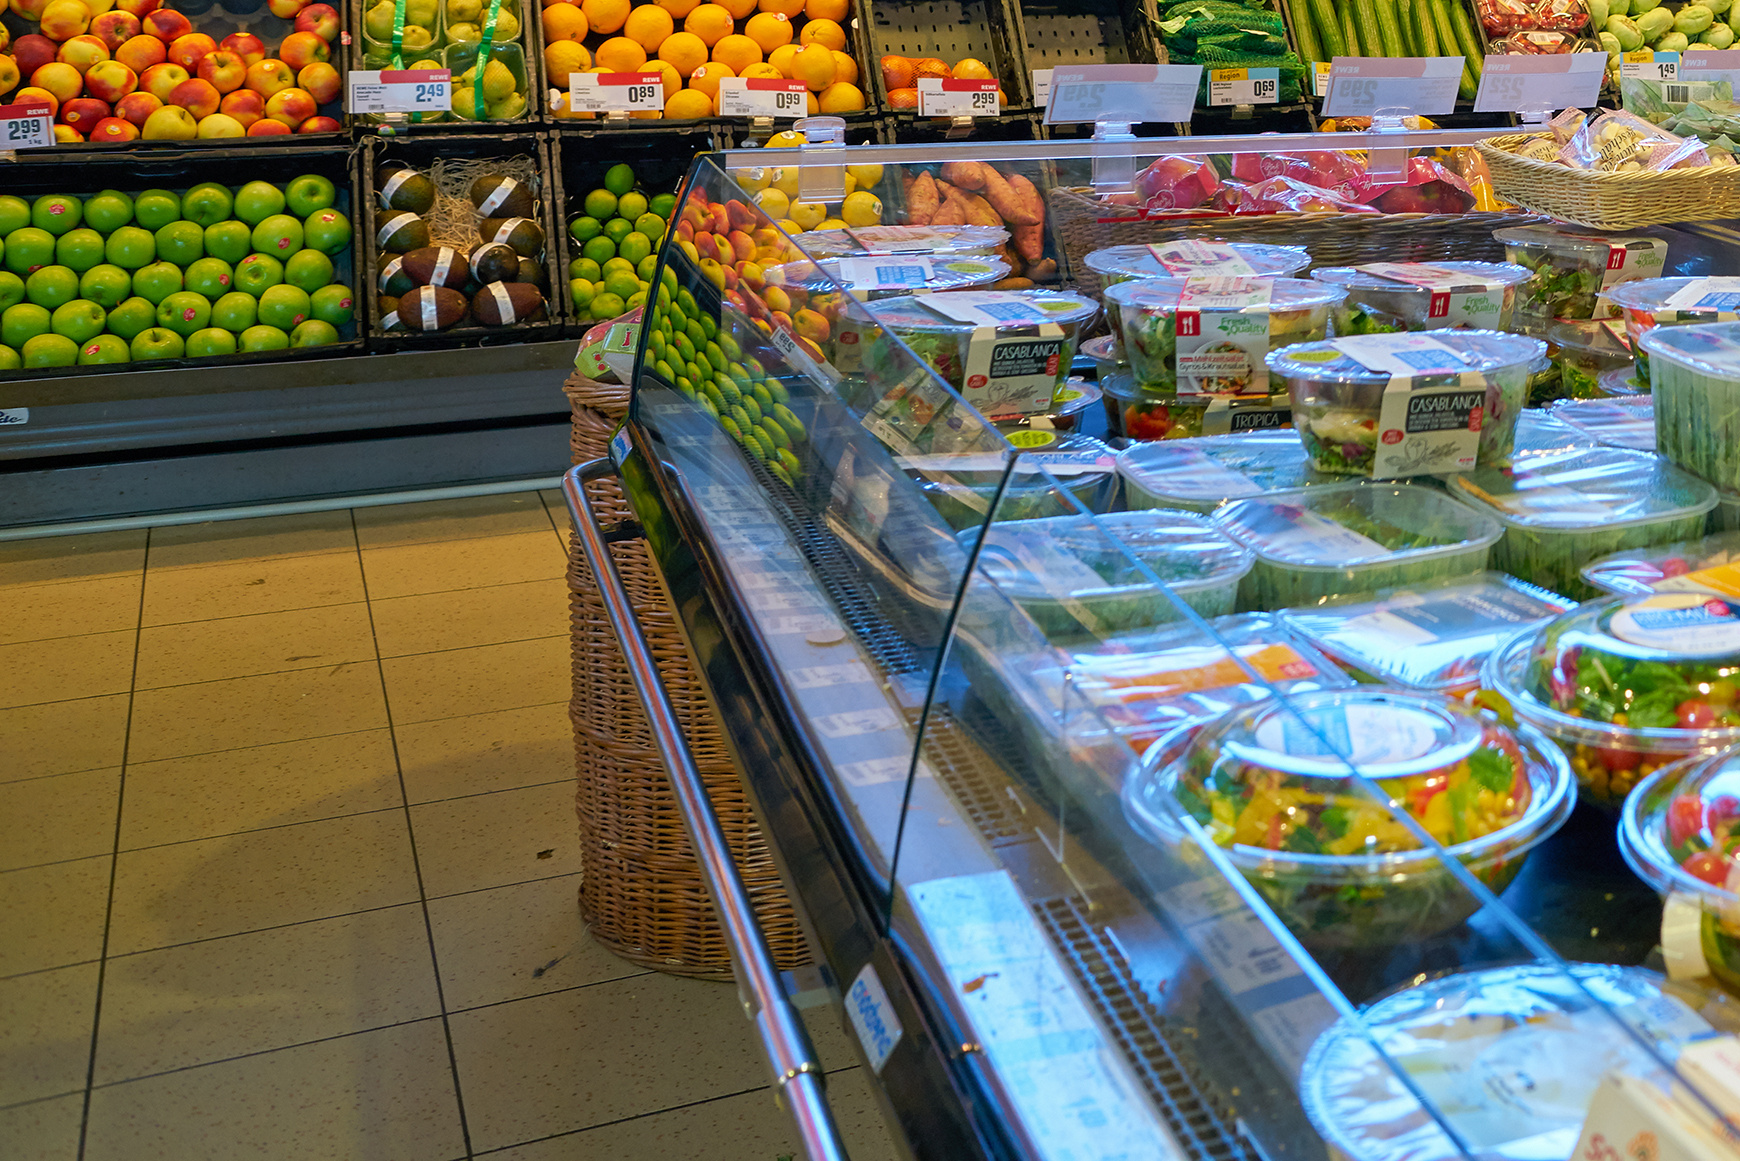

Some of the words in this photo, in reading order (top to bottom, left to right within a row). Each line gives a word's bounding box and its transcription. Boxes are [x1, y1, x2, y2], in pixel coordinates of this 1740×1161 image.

[1219, 71, 1241, 81] Region
[1658, 64, 1675, 77] 1.49
[416, 84, 444, 102] 2.49
[628, 86, 655, 103] 0.89
[1254, 81, 1275, 96] 0.69
[776, 92, 800, 109] 0.99
[972, 93, 995, 108] 2.99
[8, 120, 41, 140] 2.99
[1641, 258, 1664, 268] Quality
[1466, 297, 1488, 306] Fresh
[1472, 303, 1500, 315] Quality
[1220, 317, 1250, 327] Fresh
[1229, 323, 1267, 336] Quality
[994, 343, 1060, 360] CASABLANCA
[1410, 395, 1483, 413] CASABLANCA
[1235, 414, 1279, 428] TROPICA
